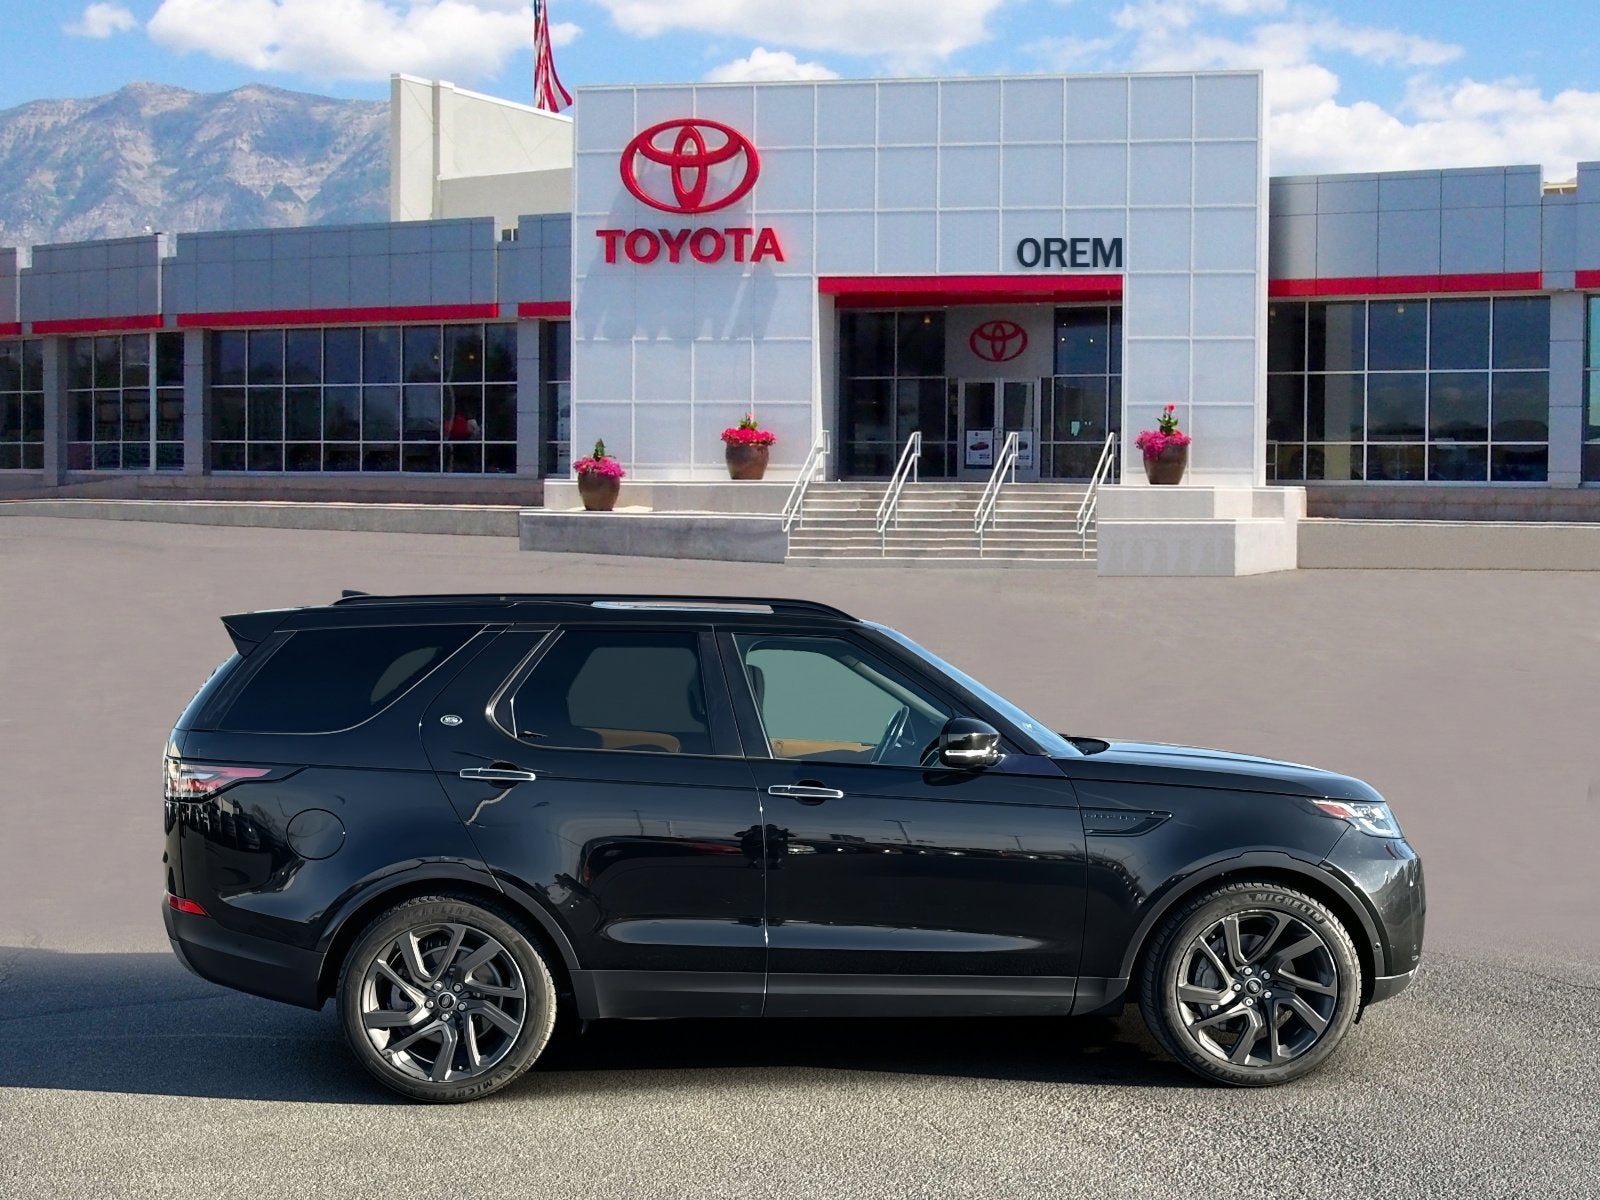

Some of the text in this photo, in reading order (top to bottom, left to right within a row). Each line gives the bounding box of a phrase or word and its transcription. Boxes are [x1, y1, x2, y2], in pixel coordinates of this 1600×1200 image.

[596, 227, 784, 264] TOYOTA
[1017, 238, 1122, 267] OREM
[1255, 893, 1324, 923] MICHELIN
